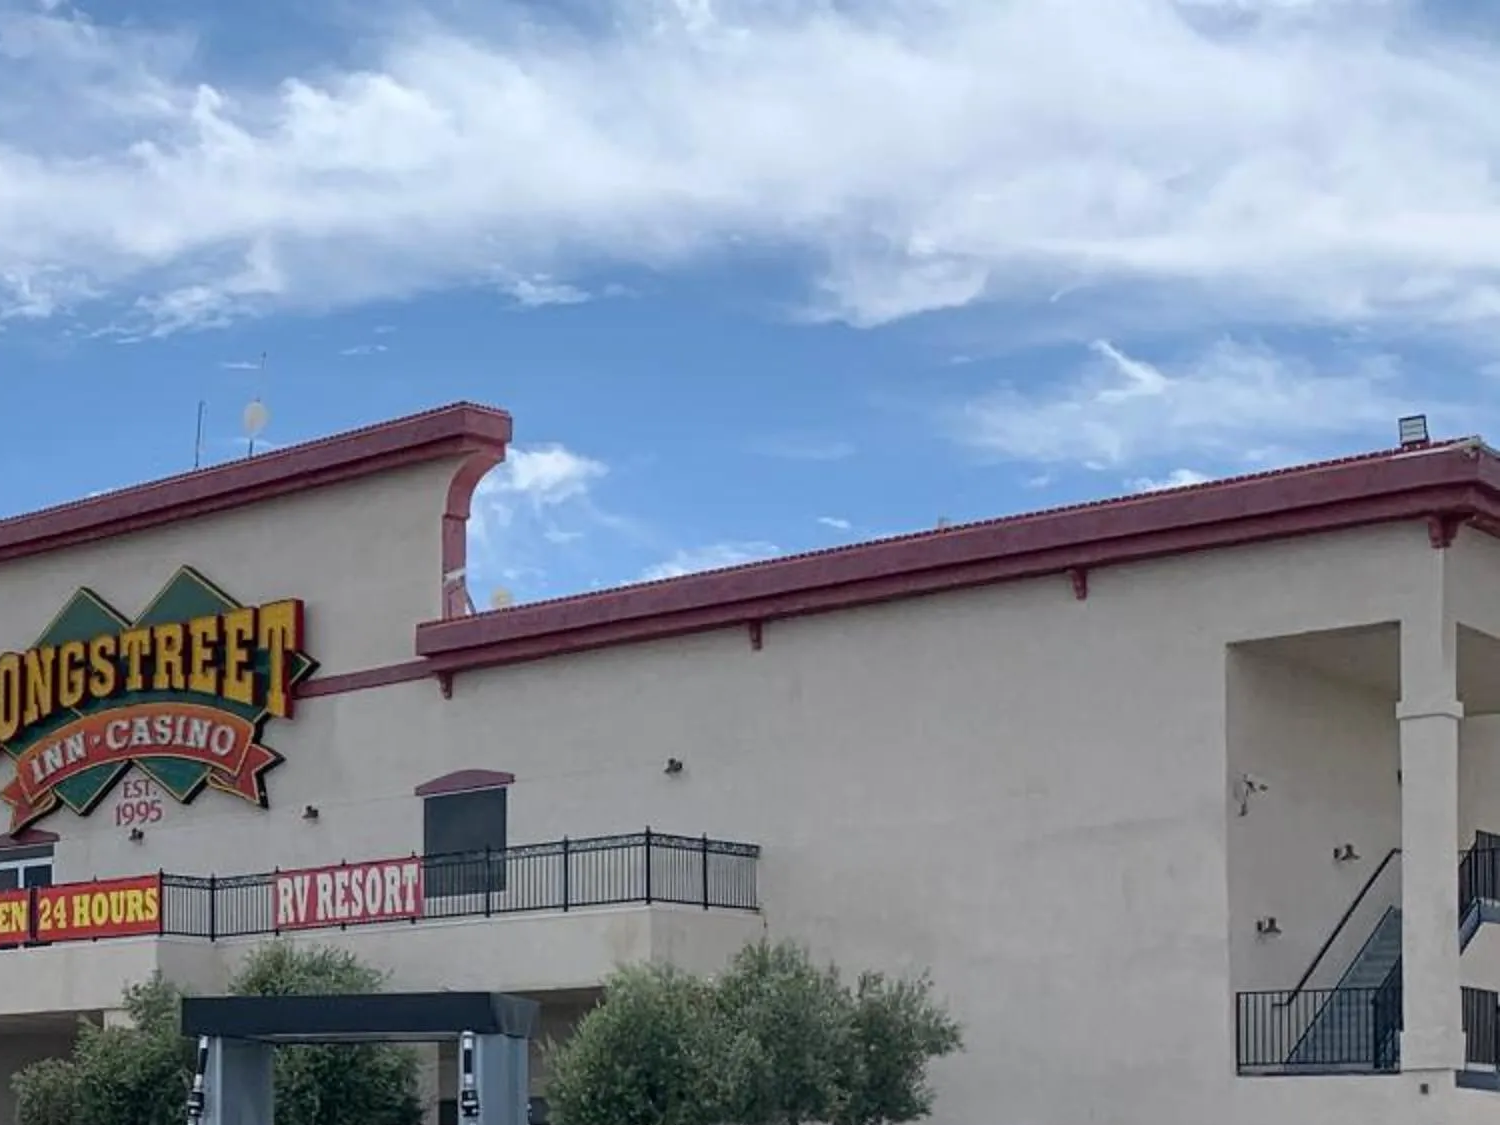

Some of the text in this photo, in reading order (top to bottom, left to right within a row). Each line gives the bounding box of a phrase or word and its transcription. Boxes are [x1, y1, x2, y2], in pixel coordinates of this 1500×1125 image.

[30, 715, 236, 784] INN CASINO
[123, 779, 157, 799] EST.
[116, 800, 162, 826] 1995
[38, 888, 159, 931] 24 HOURS
[277, 863, 419, 924] RV RESORT
